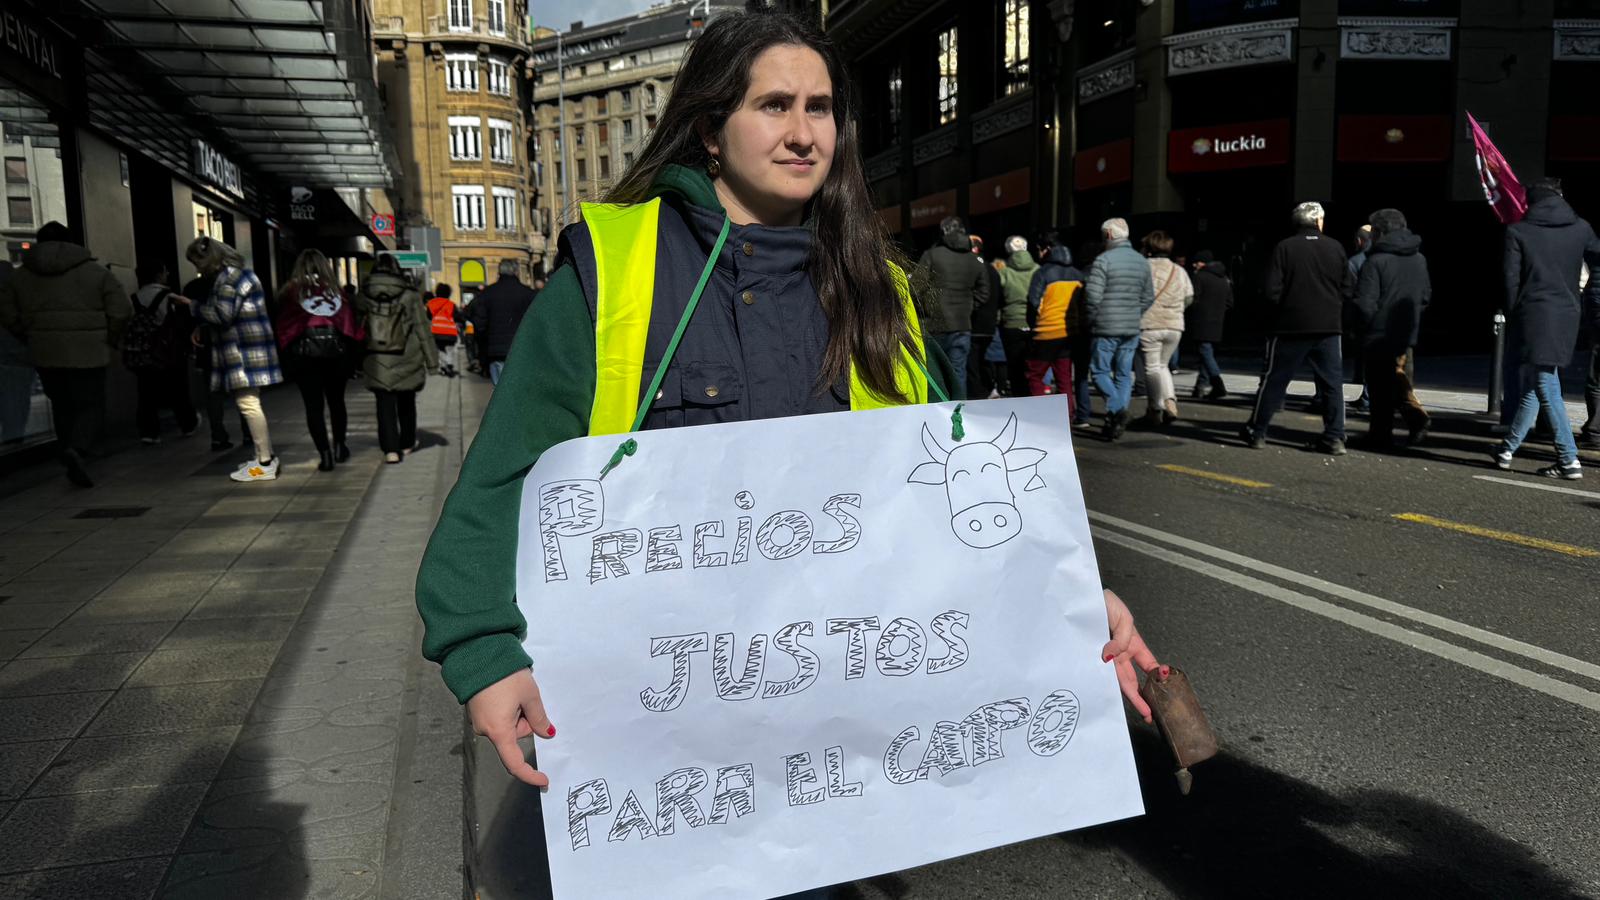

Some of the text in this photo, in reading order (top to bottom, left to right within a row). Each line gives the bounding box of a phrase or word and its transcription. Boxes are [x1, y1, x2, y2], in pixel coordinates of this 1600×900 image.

[1213, 133, 1267, 154] luckia
[198, 139, 245, 200] TACO BELL
[289, 203, 316, 211] TACO
[290, 210, 316, 221] BELL
[640, 609, 970, 713] JUSTOS
[567, 689, 1080, 852] PARA EL CAMPO
